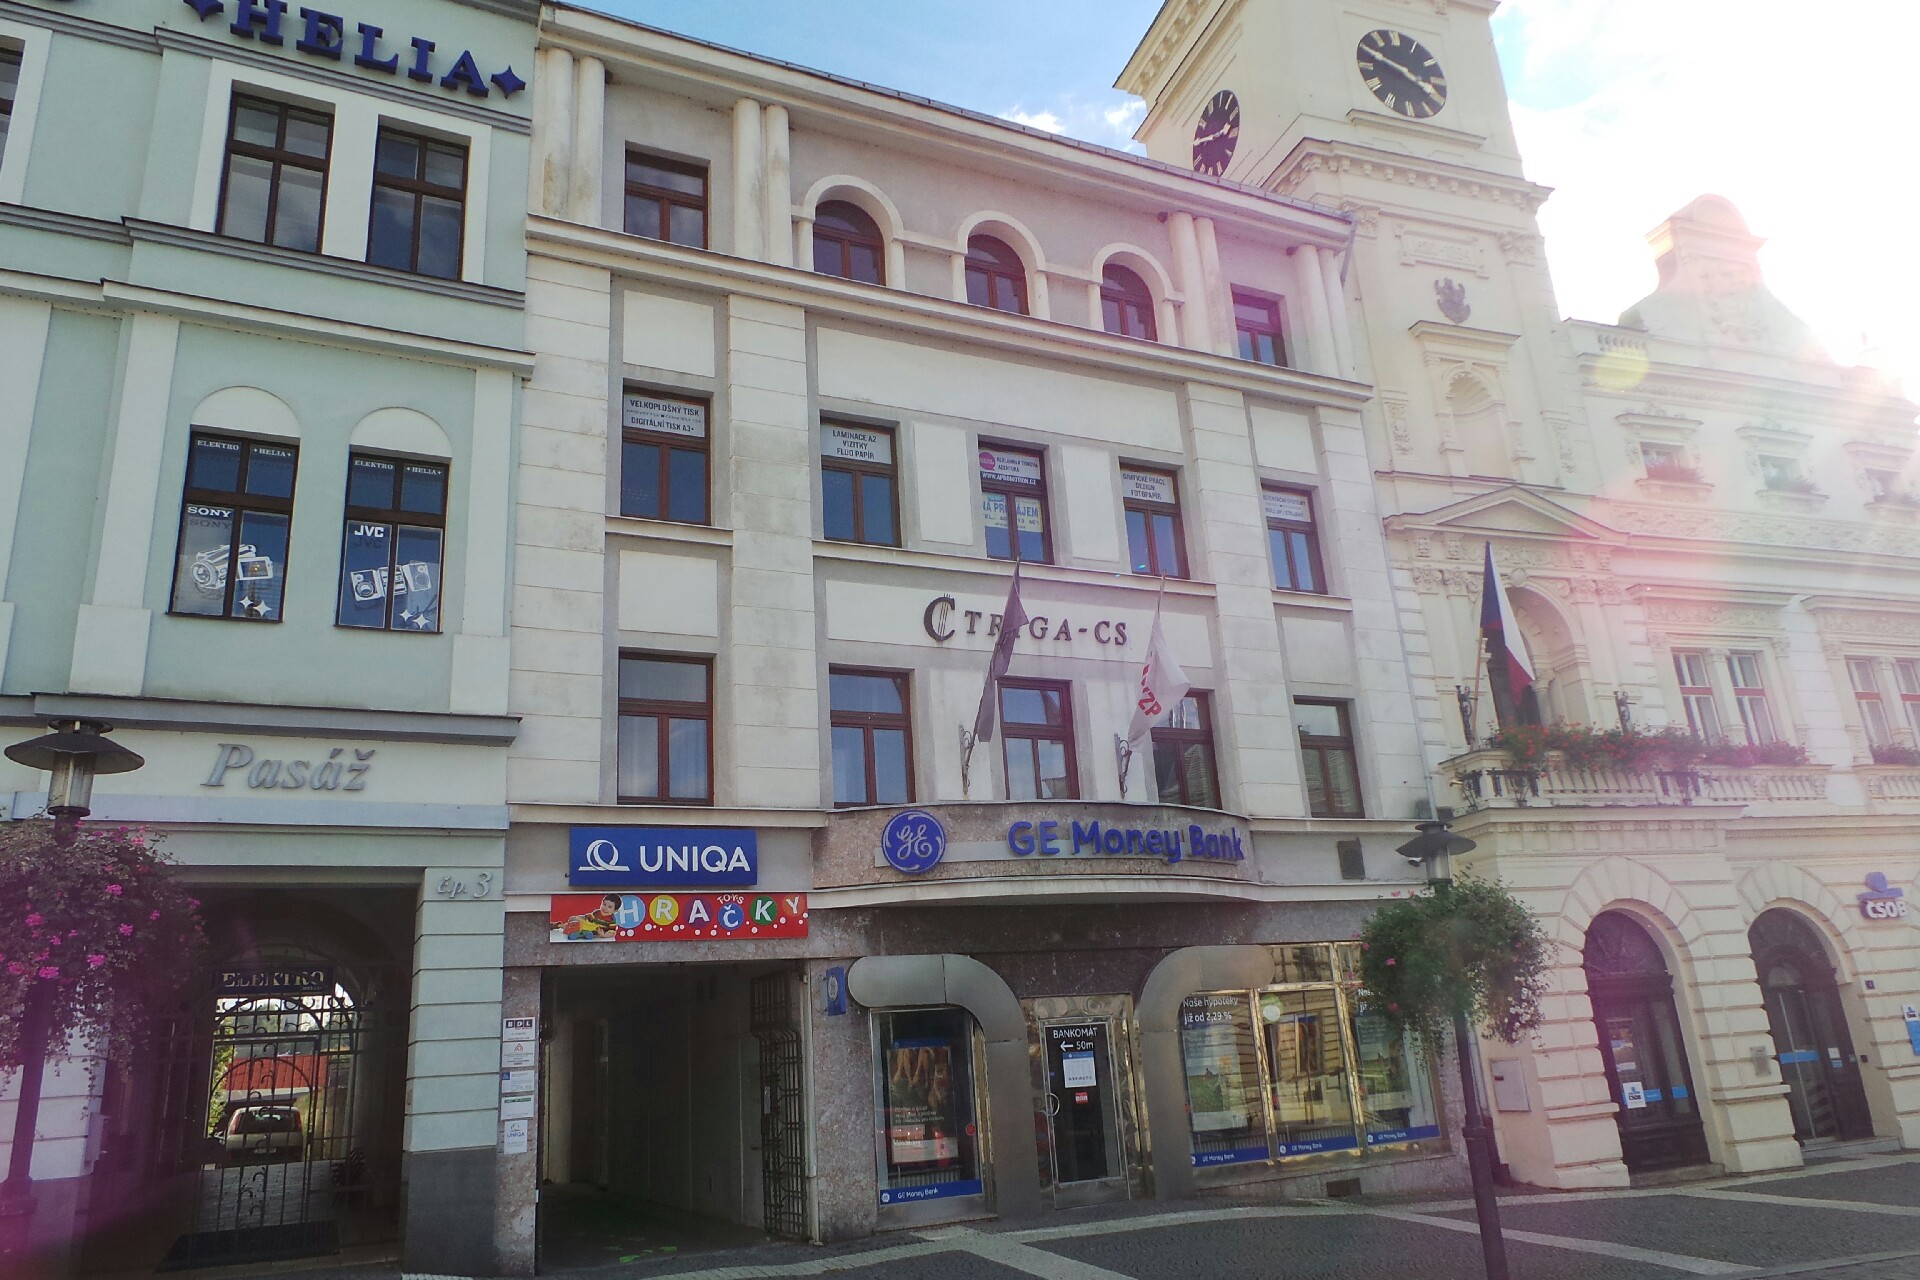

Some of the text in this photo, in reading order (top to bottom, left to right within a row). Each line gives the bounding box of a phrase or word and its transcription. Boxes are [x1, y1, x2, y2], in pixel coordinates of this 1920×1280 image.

[230, 0, 489, 97] HELIA
[630, 399, 682, 414] VELKOPLOŠNÝ
[683, 407, 700, 417] TISK
[631, 416, 665, 428] DIGITÁLNÍ
[665, 421, 681, 431] TISK
[832, 429, 877, 443] LAMINACE A2
[197, 439, 286, 457] ELEKTRO HELIA
[842, 440, 868, 450] VIZITKY
[836, 447, 875, 460] FLUO PAPÍR
[354, 460, 437, 475] ELEKTRO HELIA
[1135, 482, 1155, 491] DESIGN
[187, 505, 232, 518] SONY
[354, 524, 385, 537] JVC
[200, 743, 376, 791] Pasáž
[1008, 820, 1245, 863] GE Money Bank
[639, 845, 750, 873] UNIQA
[473, 871, 493, 898] 3
[618, 895, 801, 928] HRAČKY
[1866, 900, 1909, 919] ČSOB
[222, 970, 324, 988] ELEKTRO
[1183, 995, 1239, 1008] Naše hypotéky
[1184, 1010, 1232, 1026] již od 2,29 %
[1053, 1027, 1098, 1039] BANKOMAT
[1076, 1041, 1094, 1050] 50m
[1298, 1143, 1312, 1151] Money
[1312, 1141, 1323, 1149] Bank
[1208, 1154, 1224, 1162] Money
[906, 1190, 925, 1198] Money
[924, 1186, 938, 1195] Bank
